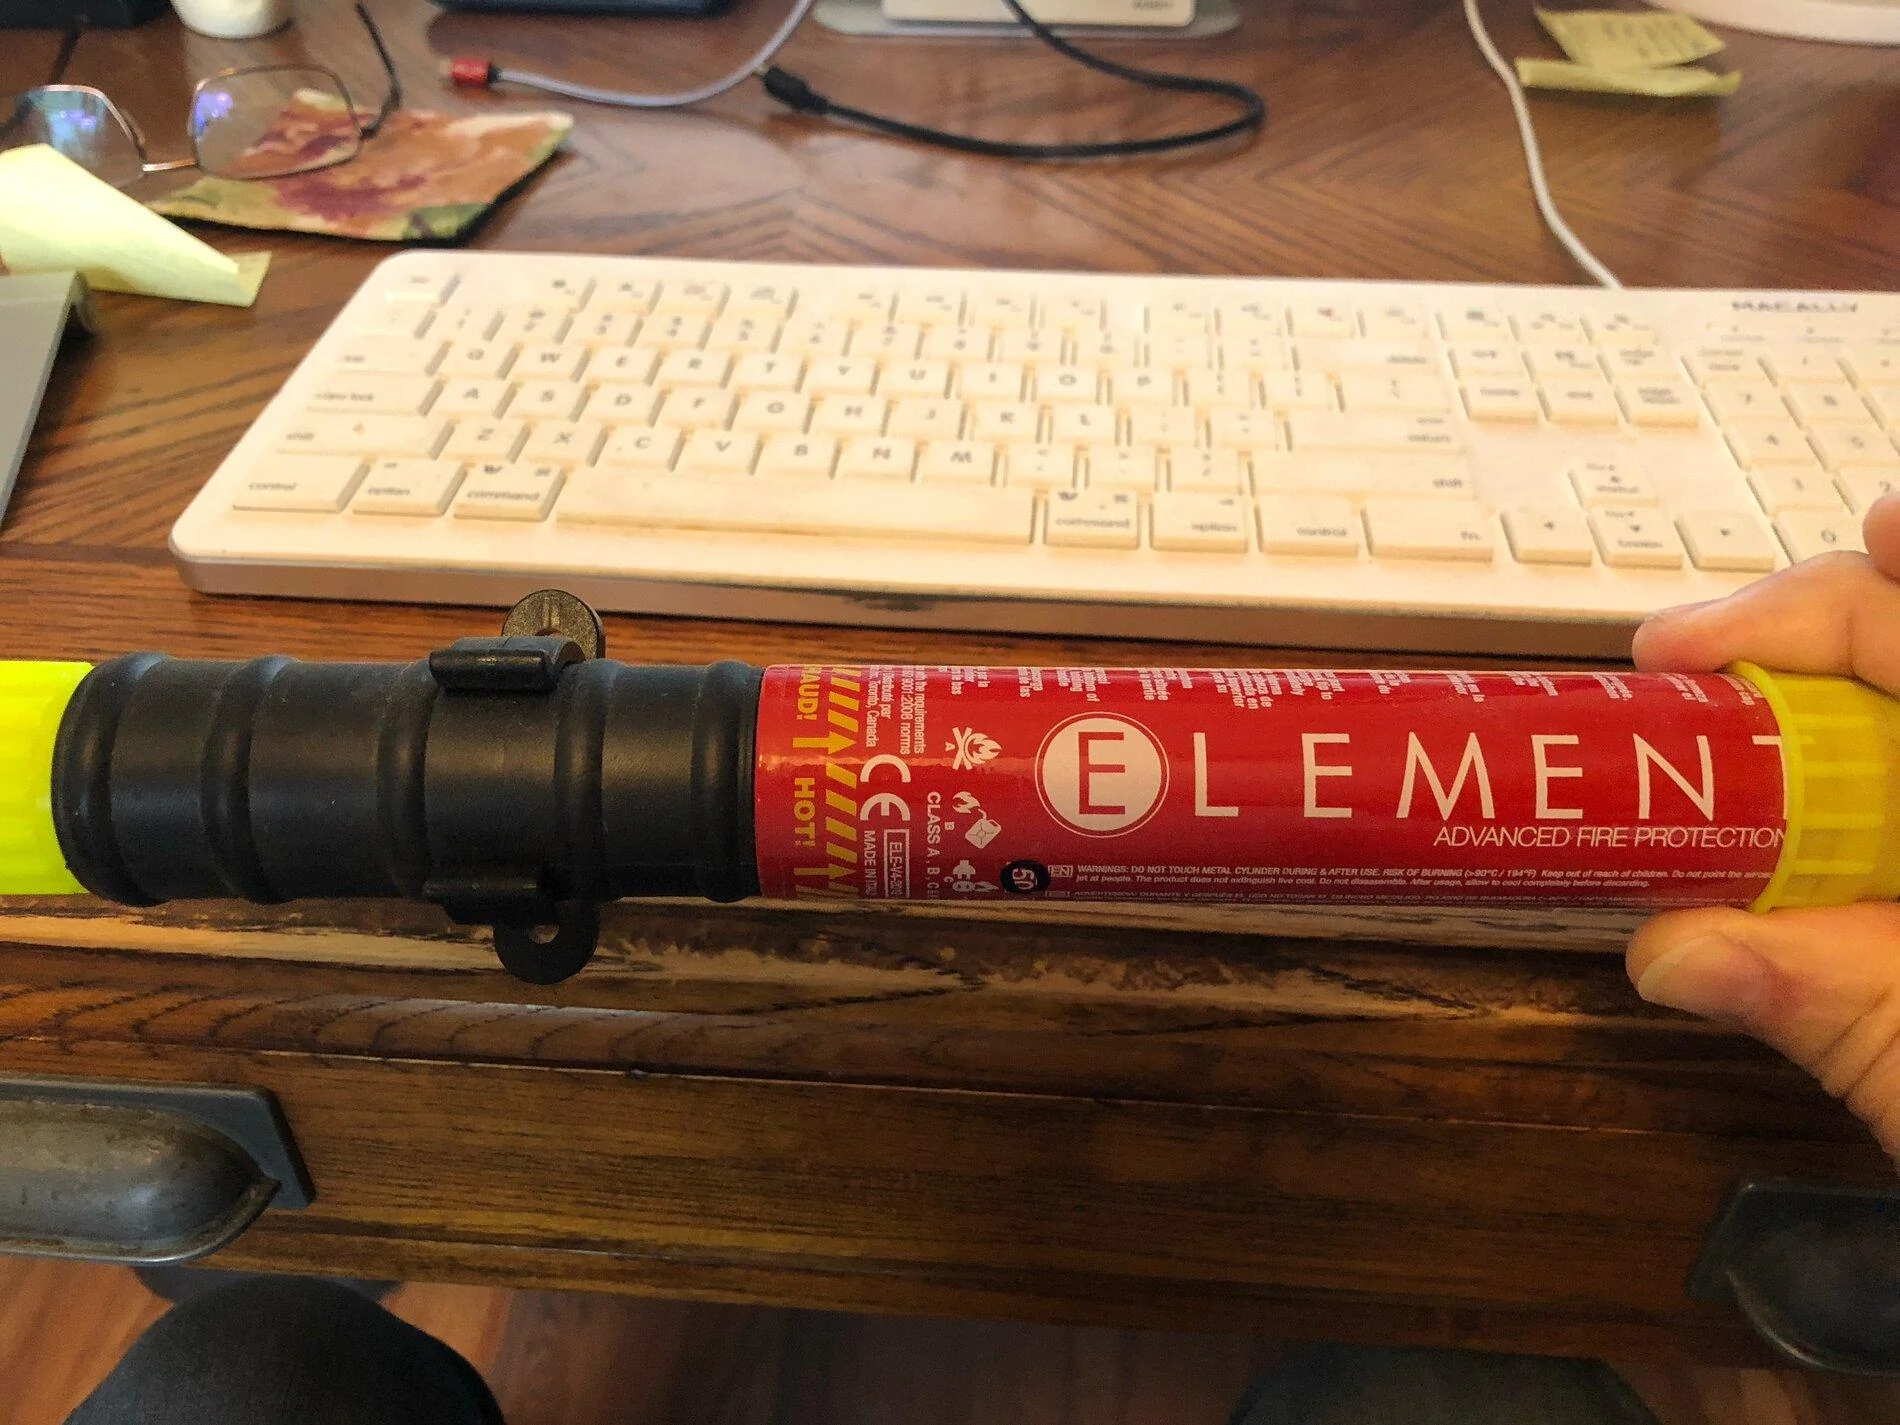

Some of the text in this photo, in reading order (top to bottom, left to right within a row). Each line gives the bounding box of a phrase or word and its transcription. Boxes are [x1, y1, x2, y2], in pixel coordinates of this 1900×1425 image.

[951, 681, 964, 695] bas
[1019, 685, 1032, 698] las
[1246, 697, 1259, 710] en
[1259, 696, 1274, 708] de
[878, 704, 891, 720] par
[865, 710, 880, 748] Canada
[913, 693, 927, 754] requirements
[900, 722, 911, 755] norms
[944, 741, 956, 752] A
[794, 777, 816, 847] HOT!
[926, 791, 942, 845] CLASS
[944, 821, 955, 831] B
[1434, 826, 1785, 848] ADVANCED FIRE PROTECTION
[863, 830, 877, 867] MADE
[864, 869, 878, 879] IN
[1077, 865, 1128, 874] WARNINGS:
[1147, 866, 1166, 874] NOT
[1168, 866, 1200, 874] TOUCH
[1201, 866, 1232, 875] METAL
[1234, 867, 1281, 875] CYLINDER
[1328, 868, 1359, 876] AFTER
[1382, 869, 1405, 877] RISK
[1406, 869, 1420, 877] OF
[1420, 869, 1463, 877] BURNING
[1541, 870, 1565, 879] Keep
[1135, 875, 1153, 883] The
